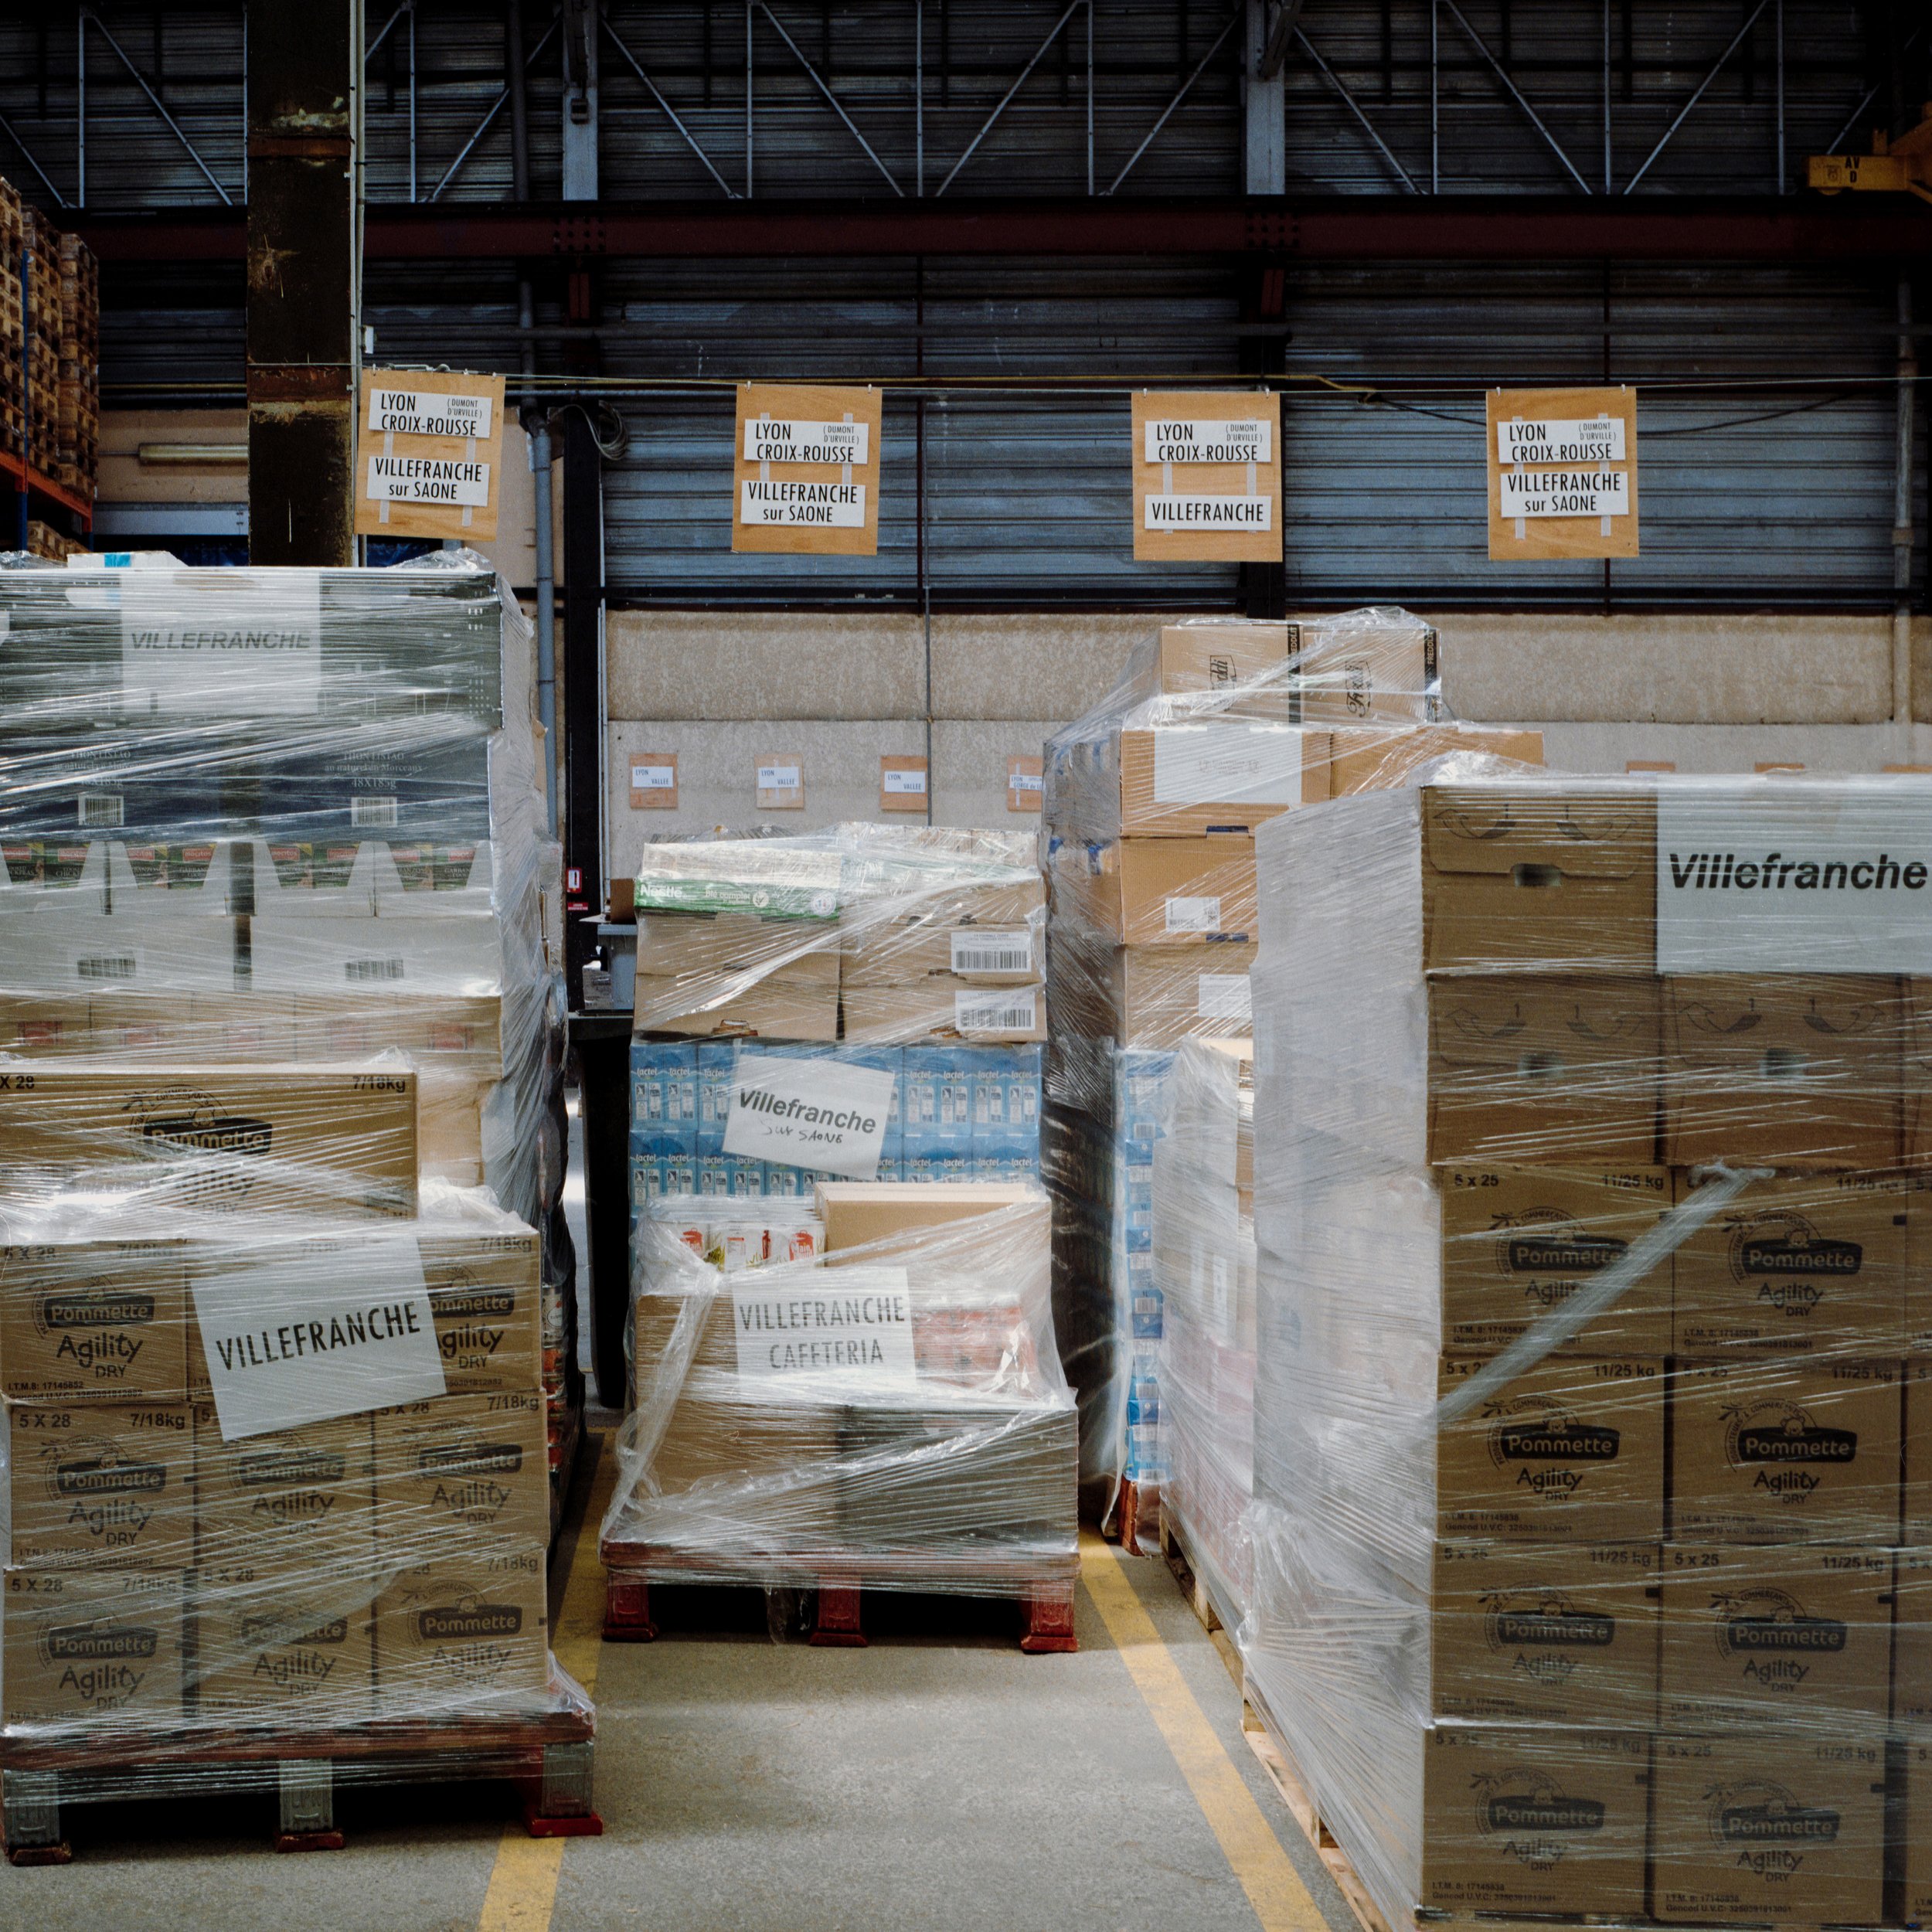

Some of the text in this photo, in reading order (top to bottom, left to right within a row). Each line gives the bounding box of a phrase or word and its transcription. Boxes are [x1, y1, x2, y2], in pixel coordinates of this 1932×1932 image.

[1845, 156, 1859, 168] AV
[379, 393, 417, 411] LYON
[380, 413, 477, 437] CROIX-ROUSSE
[755, 423, 792, 440] LYON
[1156, 423, 1194, 441] LYON
[1509, 423, 1546, 442] LYON
[757, 444, 855, 463] CROIX-ROUSSE
[1158, 444, 1258, 461] CROIX-ROUSSE
[1511, 443, 1613, 462] CROIX-ROUSSE
[374, 457, 483, 483] VILLEFRANCHE
[388, 481, 458, 500] sur SAONE
[1507, 473, 1621, 492] VILLEFRANCHE
[747, 481, 858, 505] VILLEFRANCHE
[1151, 502, 1264, 522] VILLEFRANCHE
[1524, 495, 1597, 513] sur SAONE
[763, 505, 833, 523] sur SAONE
[130, 630, 311, 651] VILLEFRANCHE
[352, 777, 396, 789] 48X185g
[1668, 852, 1928, 890] Villefranche
[15, 1076, 35, 1090] 28
[944, 1070, 965, 1080] lactel
[352, 1076, 406, 1094] 7/18kg
[739, 1087, 876, 1134] Villefranche
[151, 1128, 265, 1151] Pommette
[1454, 1173, 1500, 1187] 5 25
[1644, 1173, 1665, 1191] kg
[479, 1236, 532, 1253] 7/18kg
[1515, 1246, 1621, 1265] Pommette
[1748, 1250, 1855, 1268] Pommette
[1757, 1281, 1825, 1309] Agility
[51, 1304, 148, 1322] Pommette
[738, 1295, 906, 1331] VILLEFRANCHE
[1785, 1305, 1812, 1318] DRY
[216, 1301, 421, 1371] VILLEFRANCHE
[56, 1332, 144, 1369] Agility
[768, 1338, 884, 1370] CAFETERIA
[457, 1355, 488, 1369] DRY
[1446, 1362, 1455, 1375] 5
[1593, 1364, 1633, 1377] 11/25
[95, 1364, 127, 1379] DRY
[487, 1396, 539, 1412] 7/18kg
[19, 1413, 71, 1429] 5 X 28
[130, 1413, 186, 1430] 7/18kg
[1508, 1435, 1613, 1454] Pommette
[1745, 1437, 1850, 1456] Pommette
[63, 1471, 162, 1489] Pommette
[1515, 1468, 1584, 1494] Agility
[1752, 1470, 1821, 1496] Agility
[250, 1489, 335, 1526] Agility
[430, 1481, 513, 1518] Agility
[1781, 1492, 1808, 1505] DRY
[67, 1498, 155, 1536] Agility
[106, 1532, 138, 1546] DRY
[1590, 1550, 1651, 1567] 11/25 kg
[1674, 1553, 1683, 1566] 5
[1701, 1553, 1720, 1567] 25
[1821, 1556, 1885, 1572] 11/25 kg
[11, 1578, 63, 1593] 5 X 28
[425, 1615, 518, 1634] Pommette
[1505, 1620, 1609, 1640] Pommette
[1735, 1625, 1840, 1645] Pommette
[55, 1637, 152, 1654] Pommette
[253, 1650, 338, 1686] Agility
[1742, 1657, 1811, 1686] Agility
[59, 1664, 145, 1700] Agility
[97, 1696, 128, 1710] DRY
[1495, 1805, 1598, 1825] Pommette
[1729, 1817, 1834, 1835] Pommette
[1530, 1861, 1555, 1872] DRY
[1737, 1850, 1804, 1876] Agility
[1765, 1871, 1791, 1883] DRY
